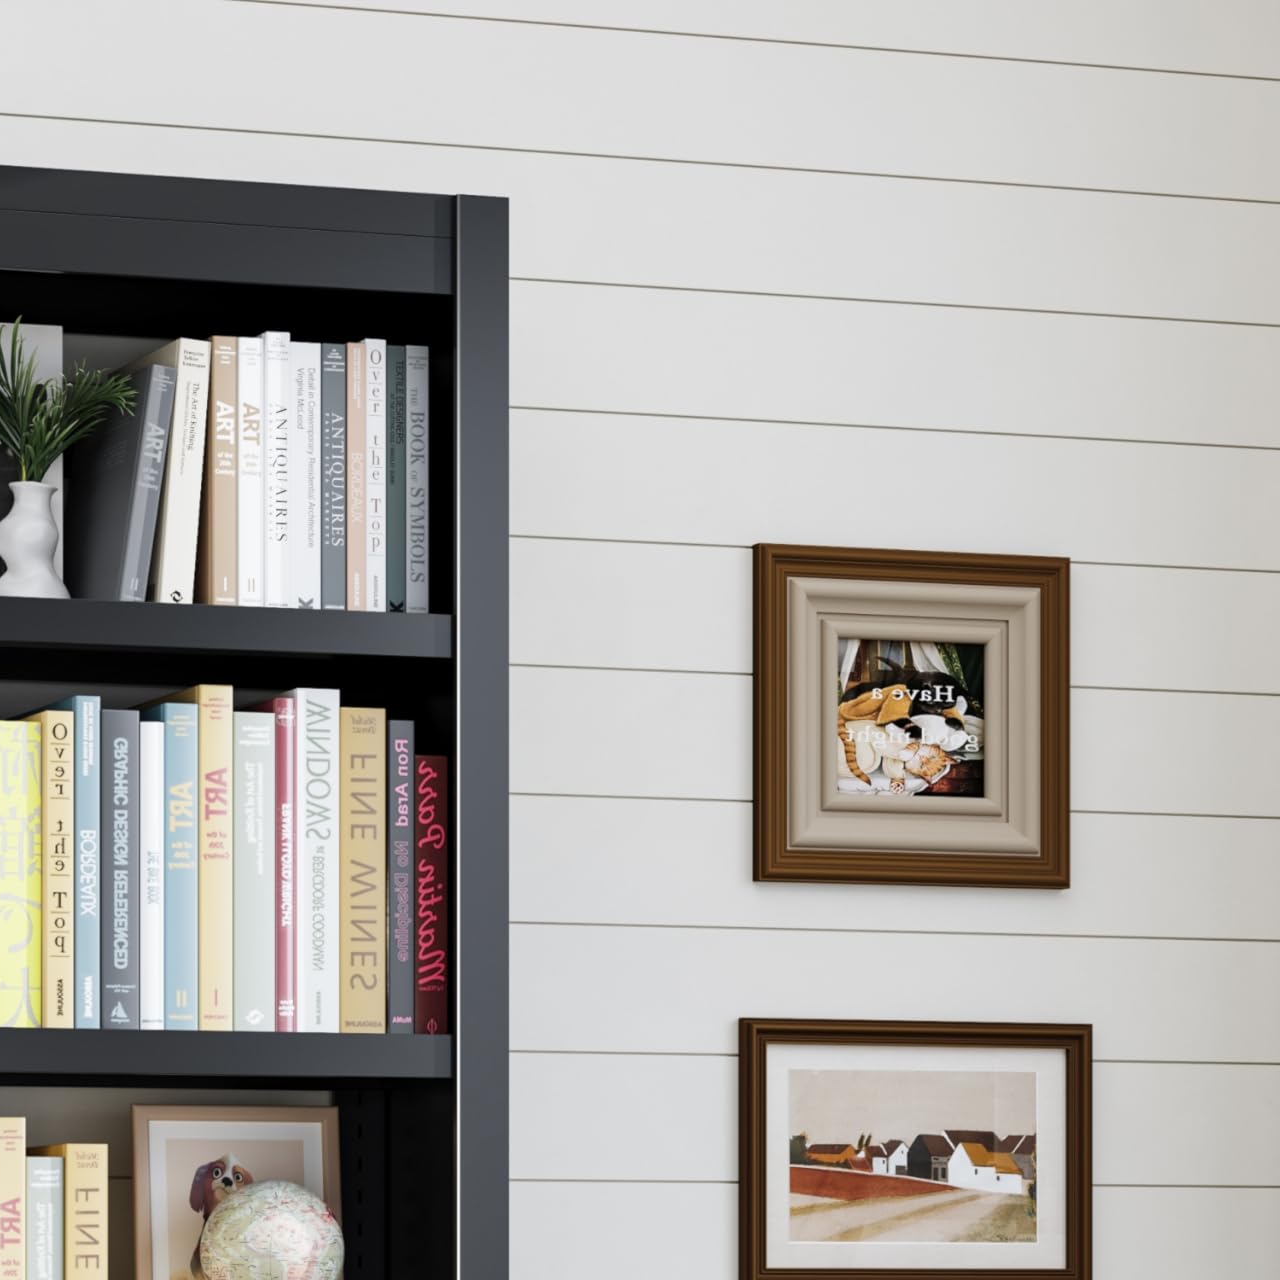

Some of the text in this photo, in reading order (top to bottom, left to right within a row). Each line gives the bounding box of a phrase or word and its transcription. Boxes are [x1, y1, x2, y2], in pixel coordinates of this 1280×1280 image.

[396, 360, 405, 394] TEXTILE
[141, 422, 166, 463] ART
[216, 401, 234, 444] ART
[242, 403, 261, 446] ART
[370, 349, 382, 553] Over the Top
[275, 405, 288, 542] ANTIQUAIRES
[331, 412, 345, 547] ANTIQUAIRES
[410, 412, 425, 582] BOOK SYMBOLS
